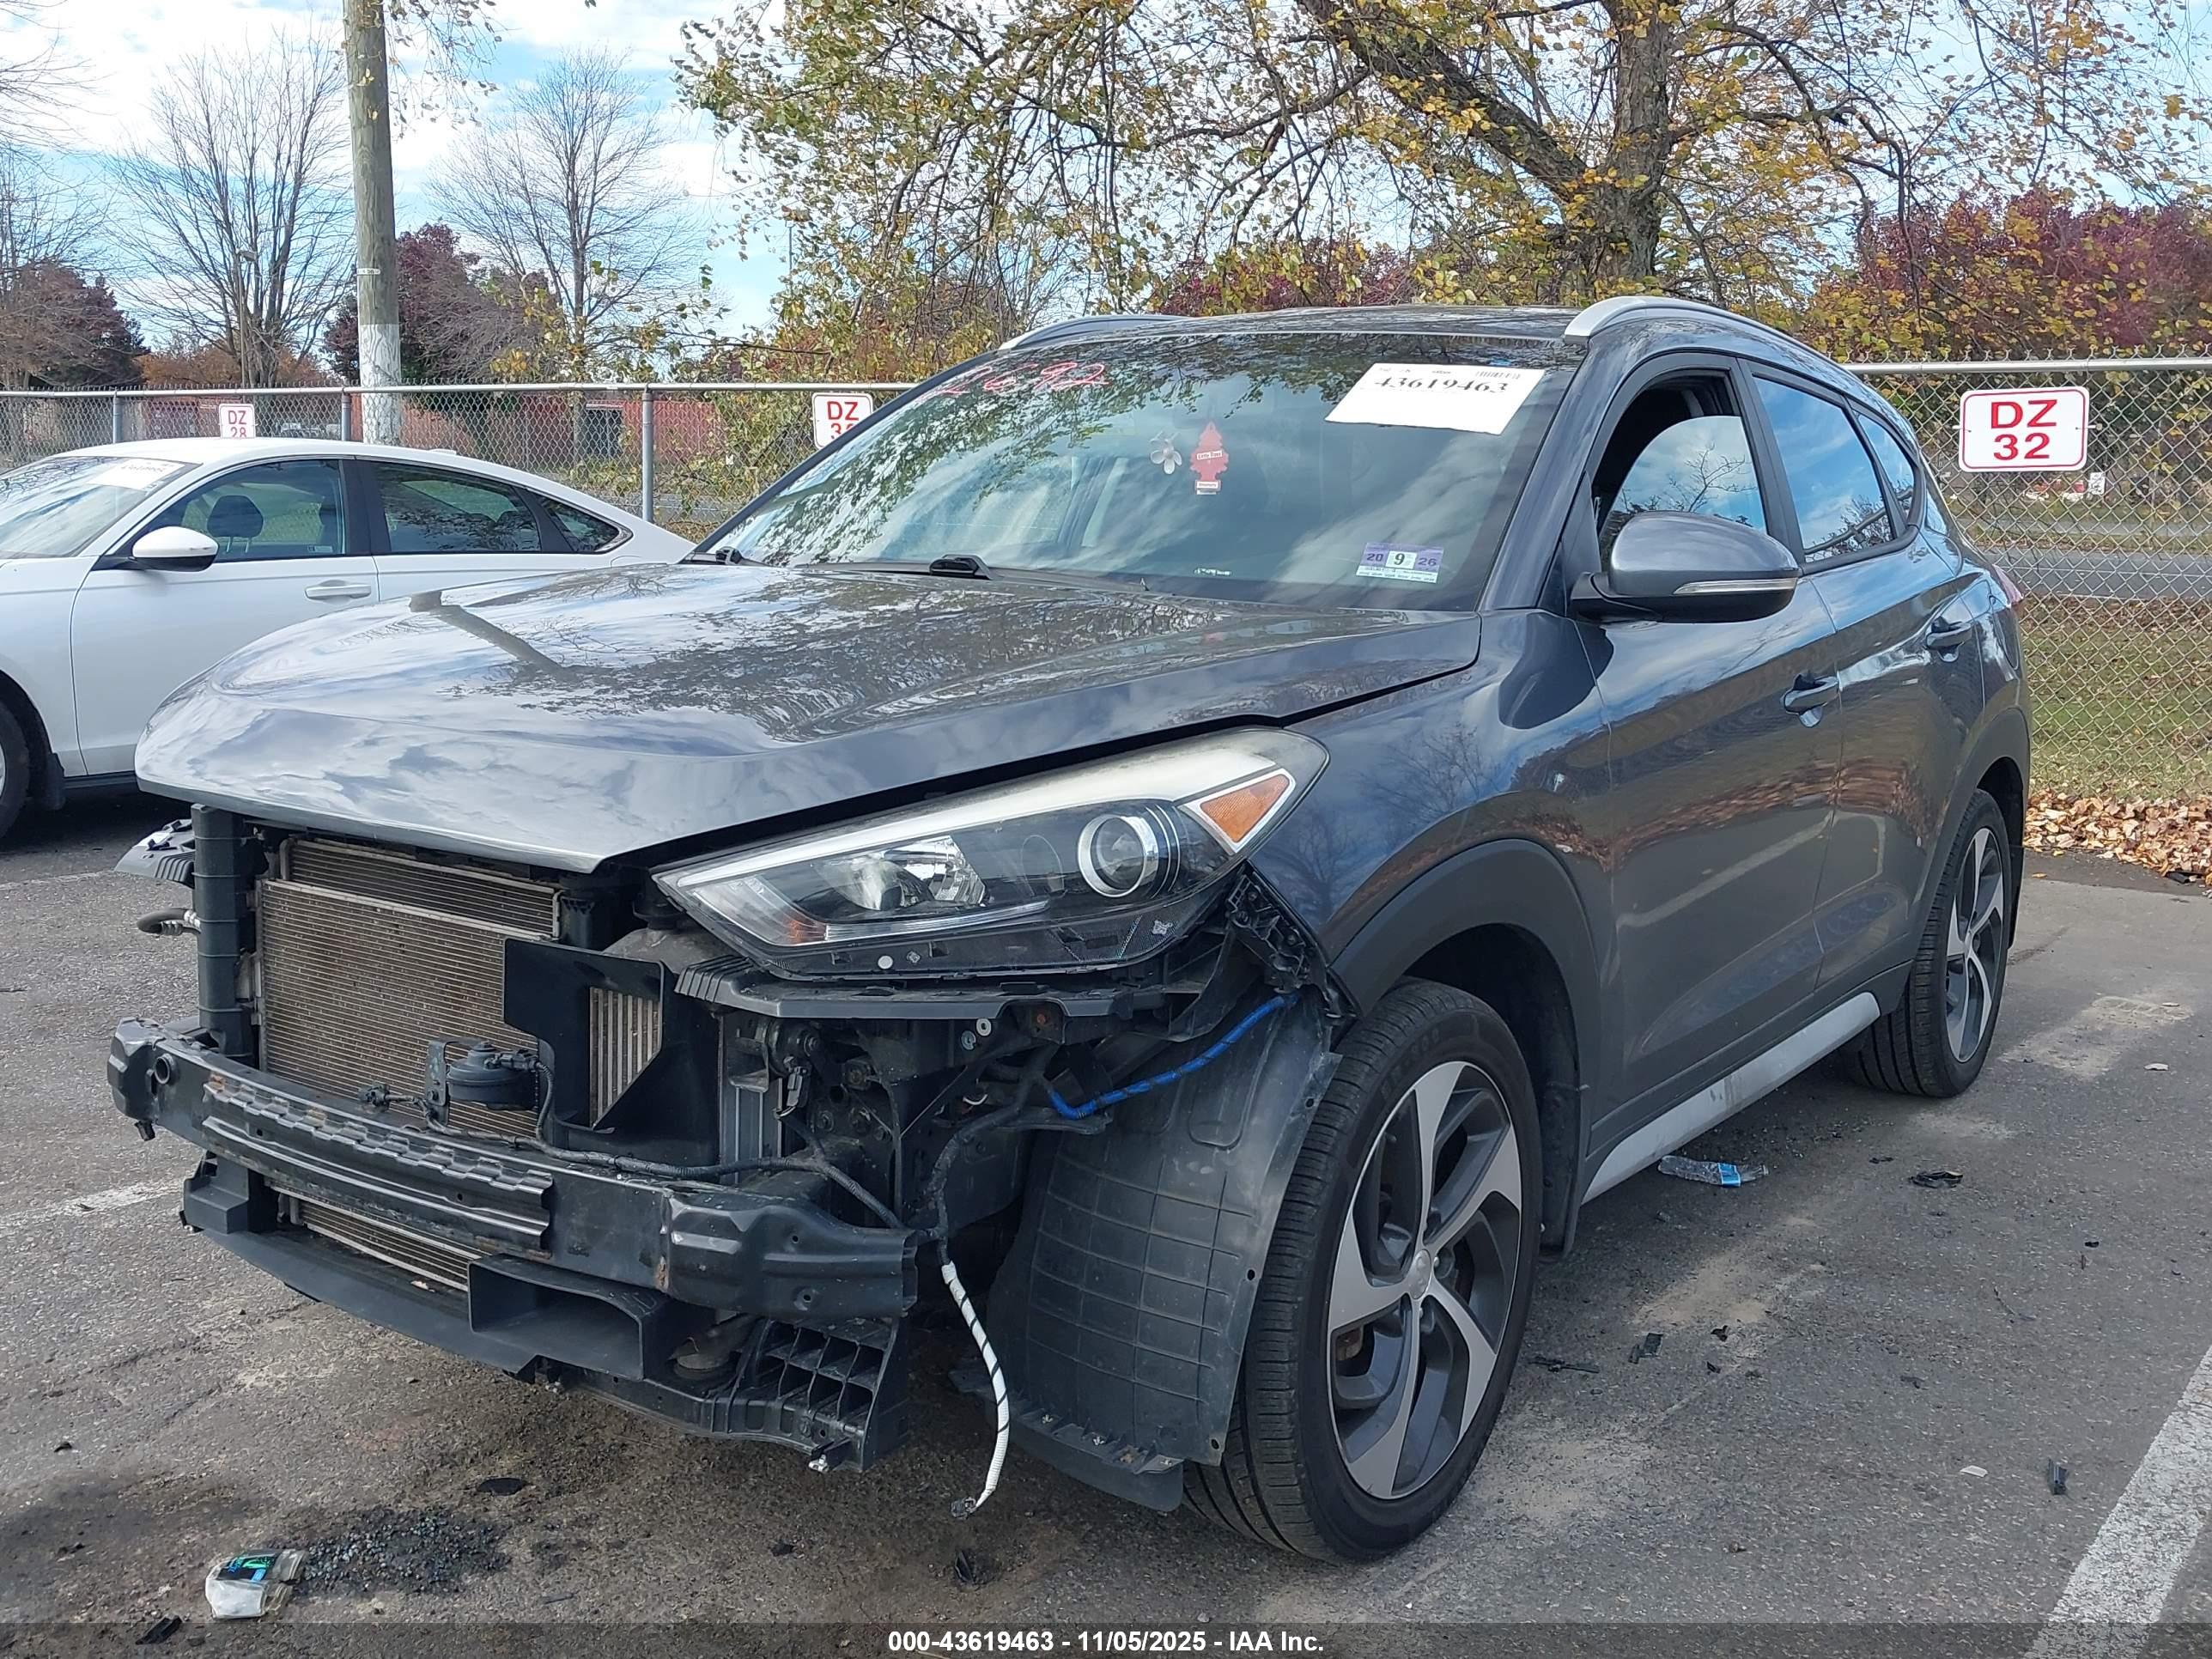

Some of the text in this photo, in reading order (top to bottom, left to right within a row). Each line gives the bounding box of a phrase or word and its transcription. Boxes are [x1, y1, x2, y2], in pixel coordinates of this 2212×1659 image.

[1375, 376, 1510, 394] 43619463
[228, 410, 247, 425] DZ
[826, 401, 859, 421] DZ
[1990, 399, 2057, 428] DZ
[230, 426, 247, 438] 28
[1993, 432, 2050, 461] 32
[1366, 553, 1437, 567] 20 9 26
